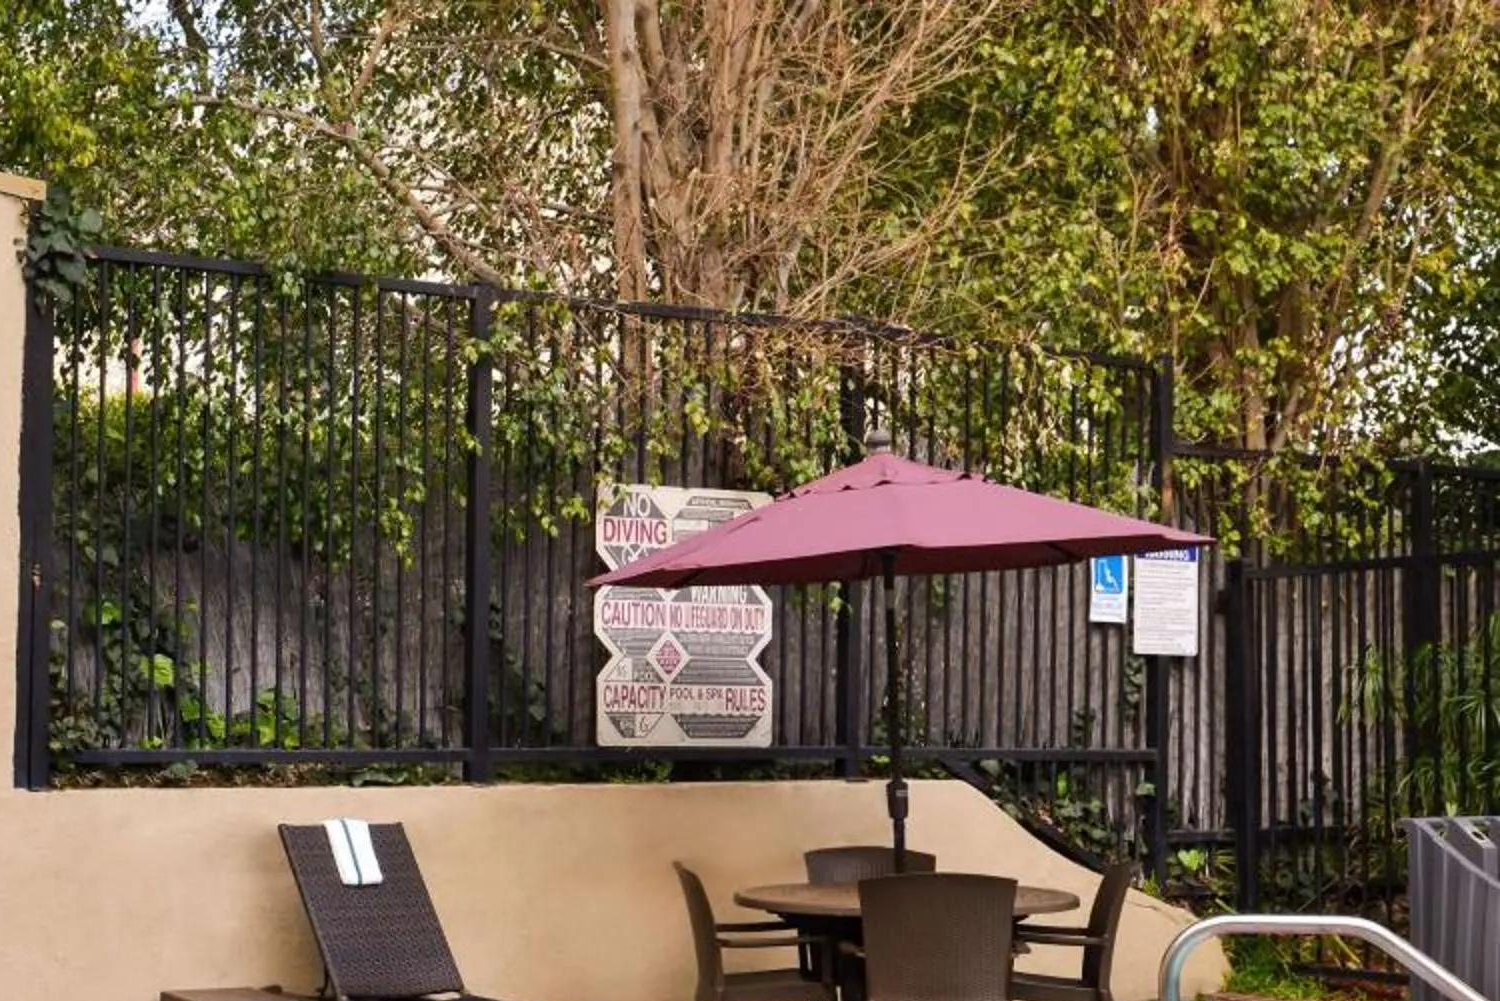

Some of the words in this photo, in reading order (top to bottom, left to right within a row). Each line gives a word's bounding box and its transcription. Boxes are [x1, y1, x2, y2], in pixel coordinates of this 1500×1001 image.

[623, 492, 651, 517] NO
[603, 519, 667, 545] DIVING
[601, 601, 666, 627] CAUTION
[670, 604, 683, 629] NO
[684, 605, 728, 630] LIFEGUARD
[603, 685, 666, 709] CAPACITY
[669, 687, 694, 700] POOL
[706, 687, 723, 701] SPA
[725, 687, 766, 712] RULES
